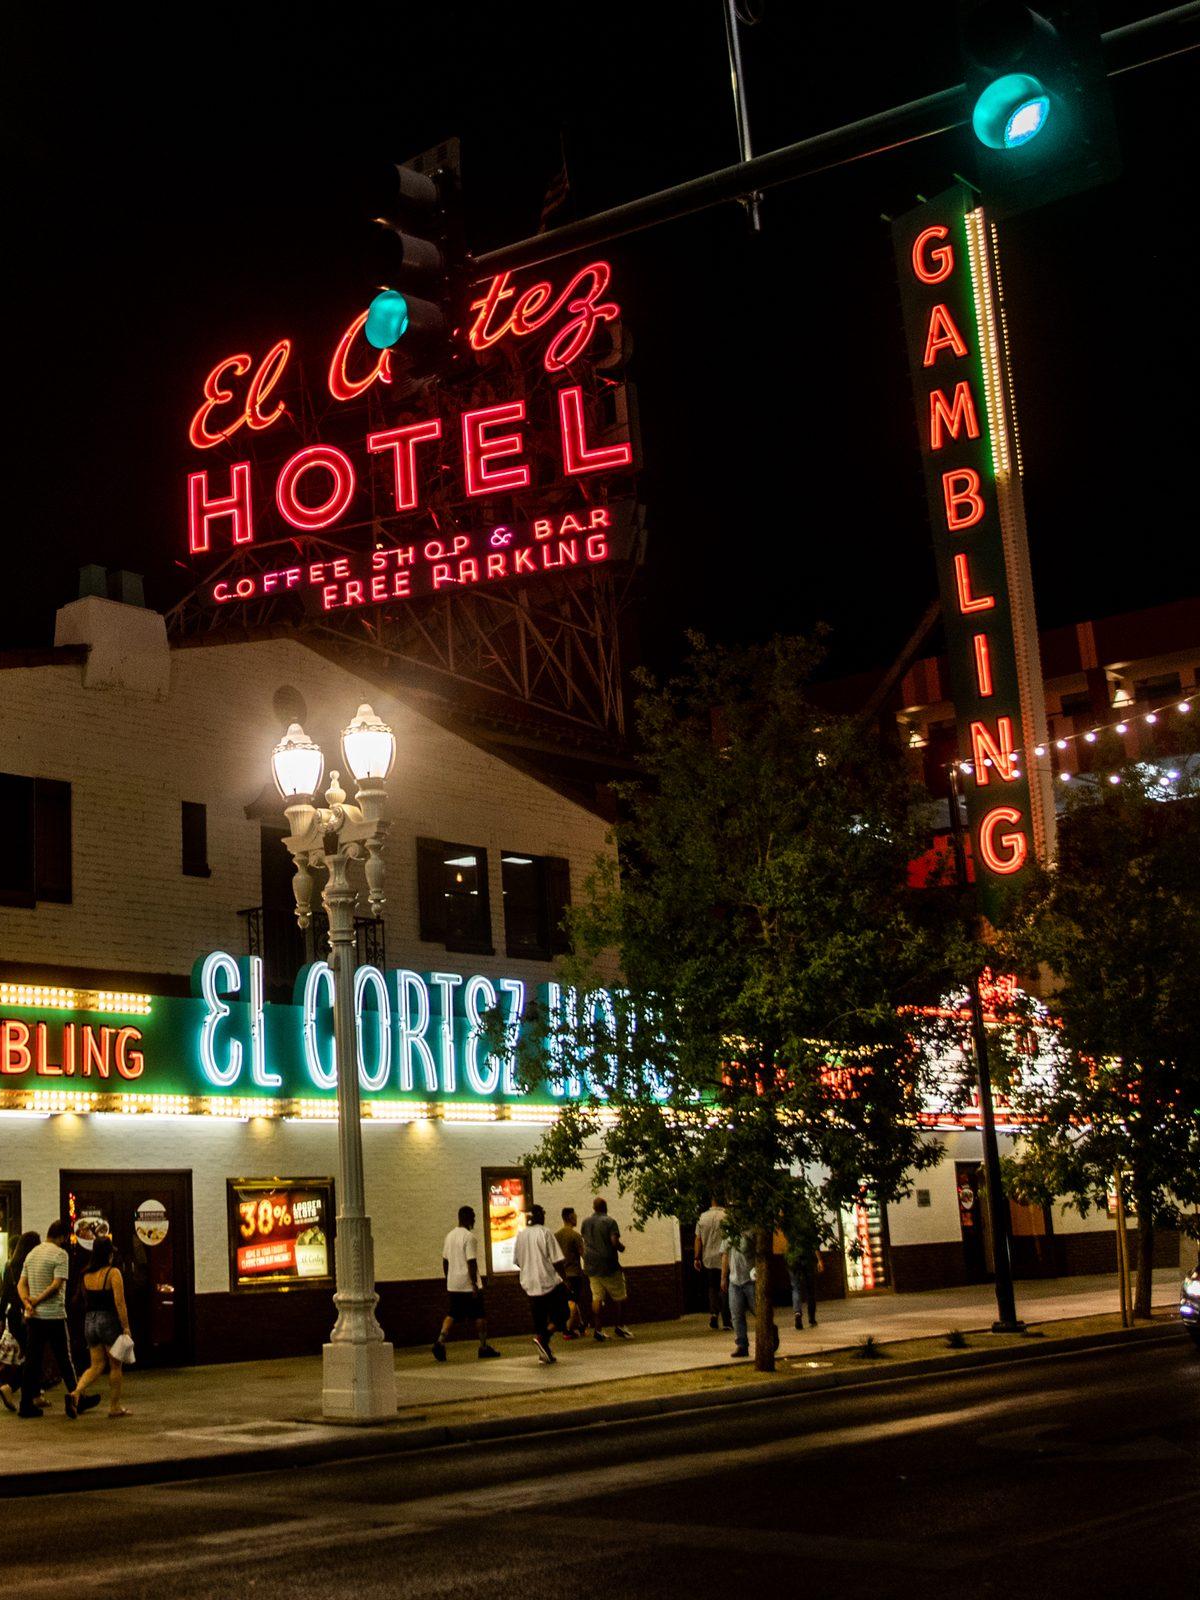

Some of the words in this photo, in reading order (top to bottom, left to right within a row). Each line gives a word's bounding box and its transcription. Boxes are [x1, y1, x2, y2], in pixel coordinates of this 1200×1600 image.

[188, 338, 292, 450] El
[327, 261, 621, 401] Ctez
[187, 385, 633, 555] HOTEL
[213, 559, 350, 602] COFFEE
[371, 535, 471, 572] SHOP
[489, 526, 513, 548] &
[534, 508, 612, 540] BAR
[322, 570, 412, 611] FREE
[432, 533, 611, 590] PARKING
[911, 224, 1028, 876] GAMBLING
[202, 950, 283, 1088] EL
[303, 961, 530, 1097] CORTEZ
[240, 1199, 292, 1238] 38%
